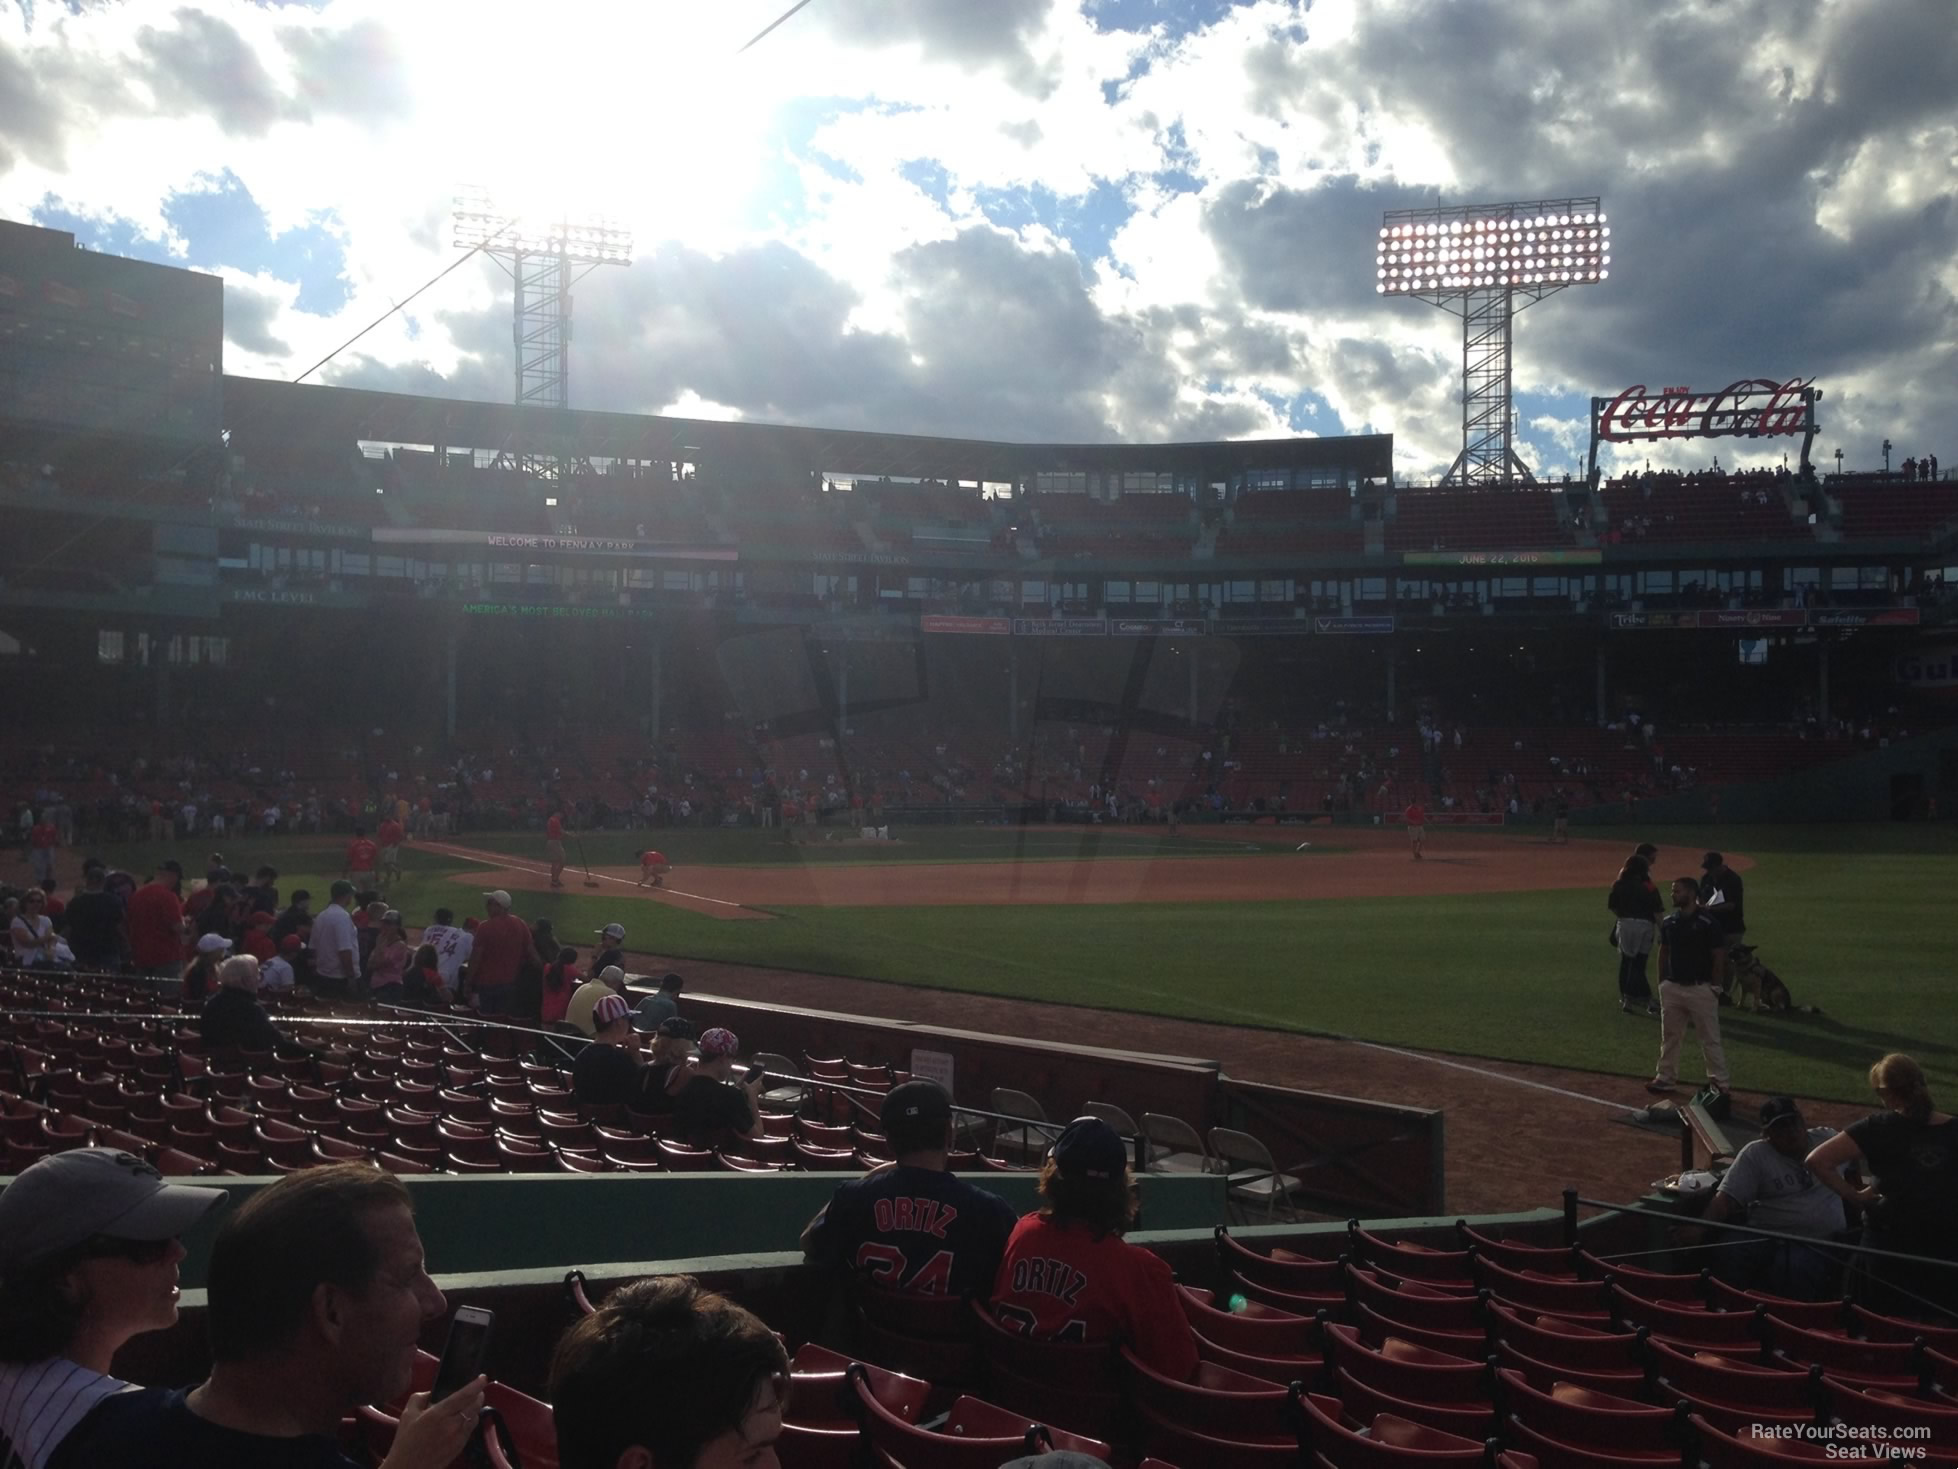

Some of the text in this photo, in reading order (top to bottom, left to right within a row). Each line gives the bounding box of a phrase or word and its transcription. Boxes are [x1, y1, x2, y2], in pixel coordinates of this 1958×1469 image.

[487, 535, 538, 548] WELCOME
[542, 538, 556, 549] TO
[559, 539, 603, 550] FENWAY
[1459, 554, 1538, 565] JUNE 22, 2016
[271, 591, 316, 603] LEVEL
[463, 604, 518, 615] AMERICA'S
[521, 605, 548, 616] MOST
[552, 607, 599, 617] BELOVED
[1613, 613, 1646, 627] Tribe
[1718, 614, 1745, 622] Ninety
[874, 1196, 957, 1240] ORTIZ
[1011, 1256, 1087, 1308] ORTIZ
